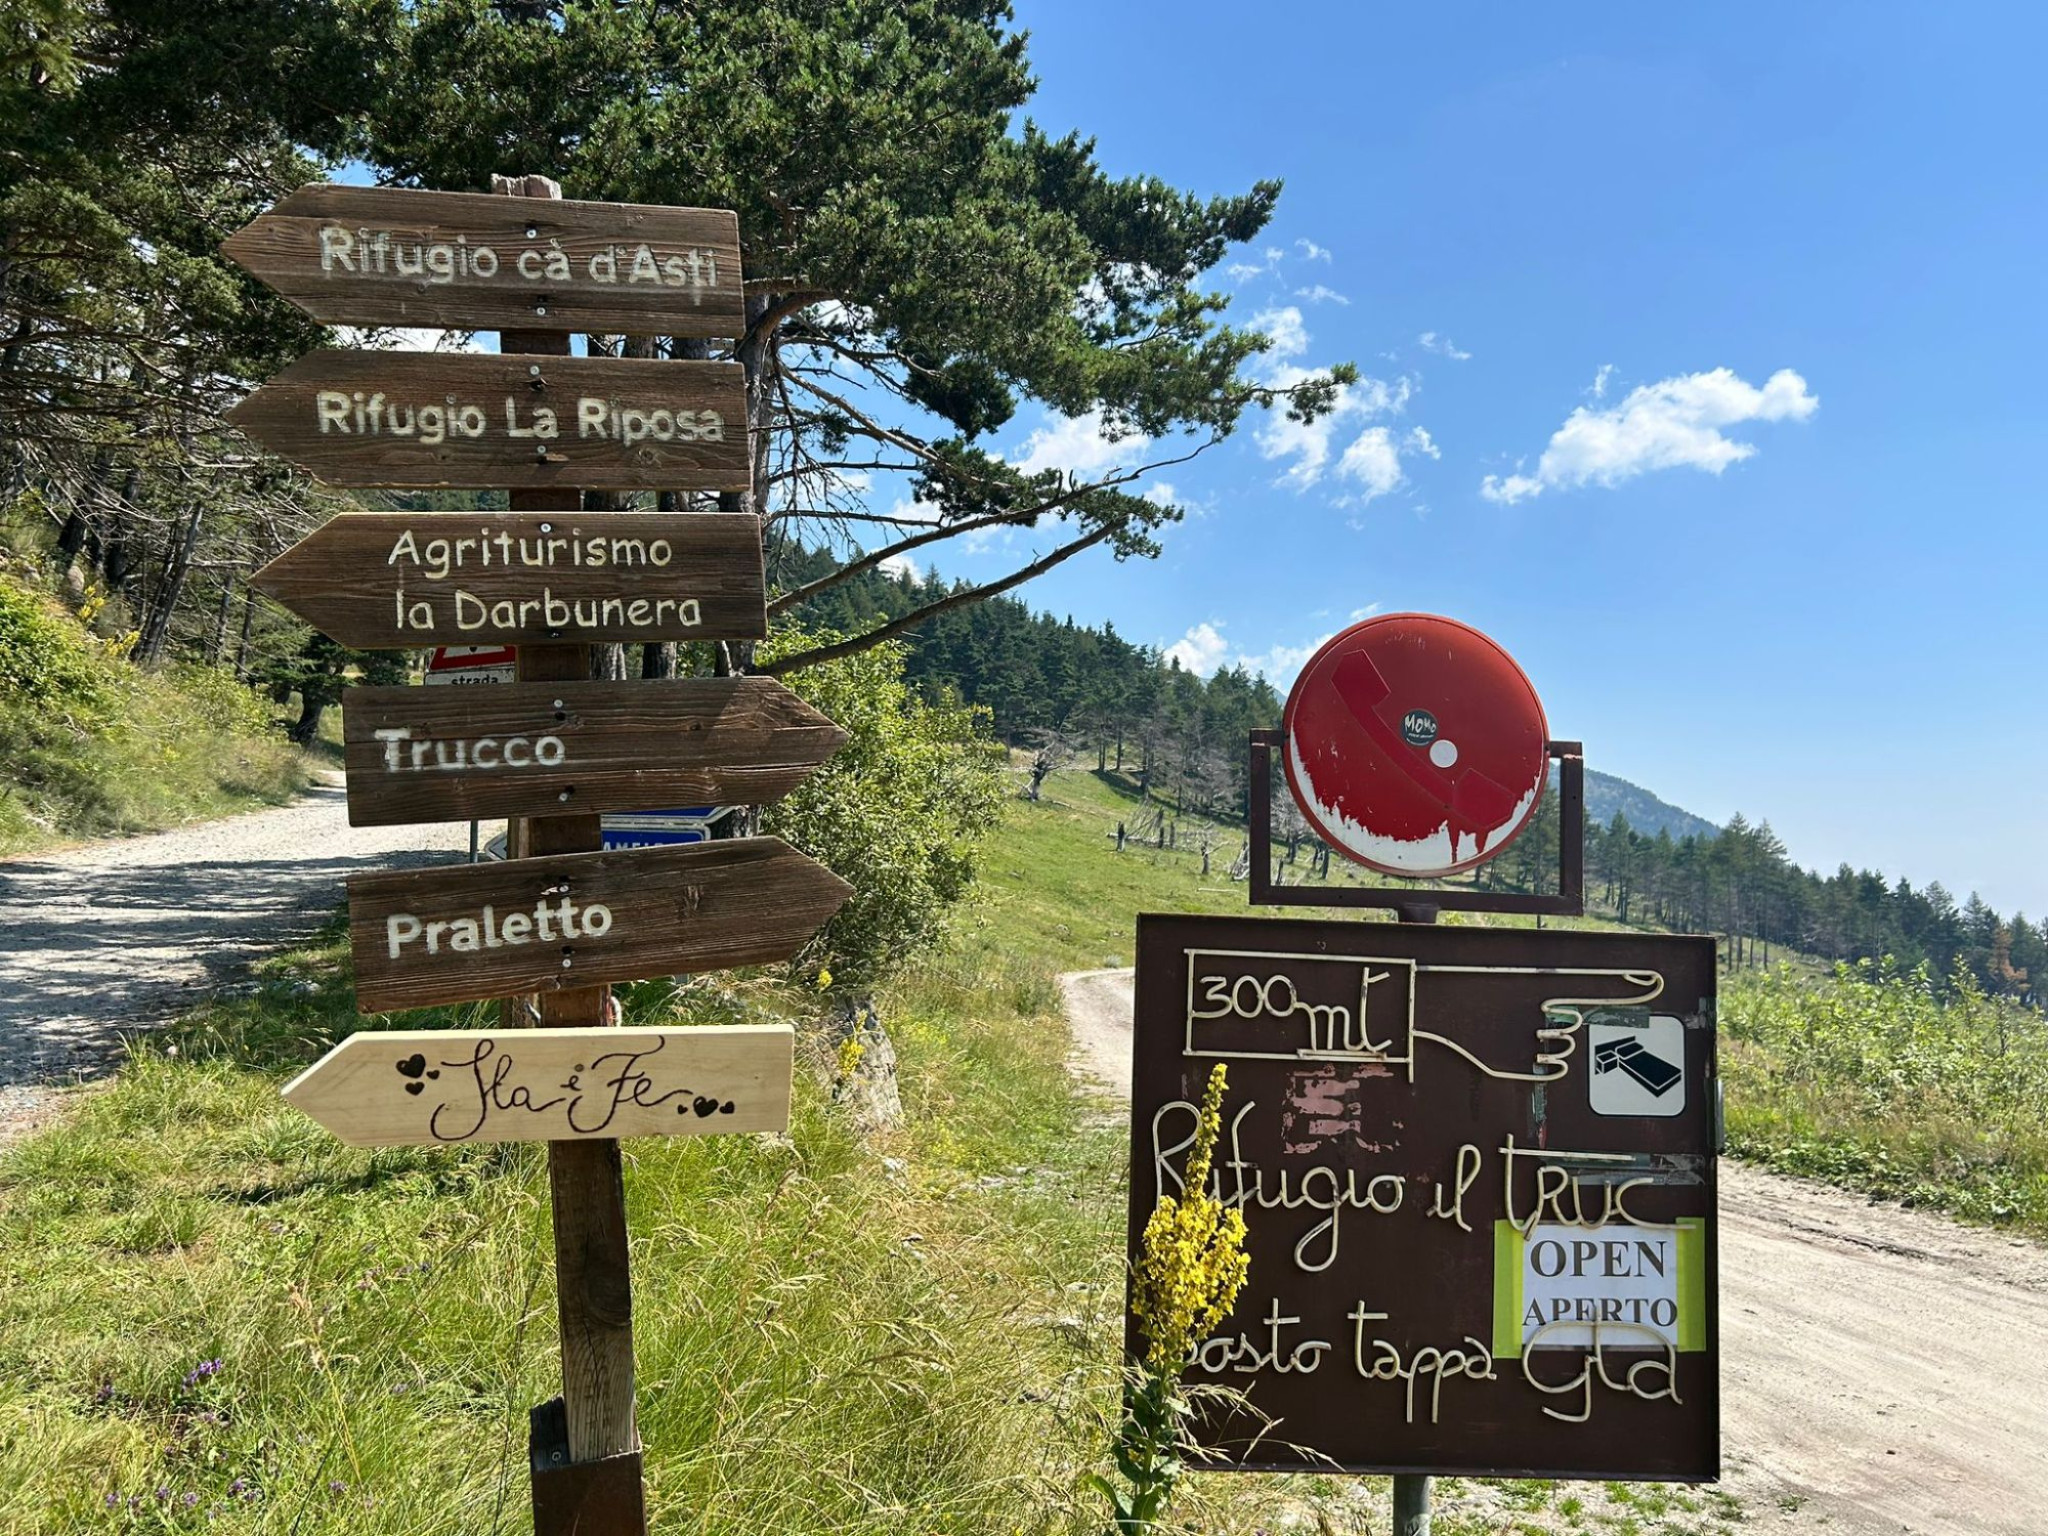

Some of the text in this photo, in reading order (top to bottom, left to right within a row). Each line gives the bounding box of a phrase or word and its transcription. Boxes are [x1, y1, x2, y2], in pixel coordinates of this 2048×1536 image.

[319, 226, 718, 288] Rifugio cà d'Asti
[316, 391, 727, 447] Rifugio La Riposa
[388, 527, 673, 579] Agriturismo
[396, 587, 702, 630] la Darbunera
[374, 729, 566, 773] Trucco
[387, 896, 613, 960] Praletto
[567, 1034, 693, 1133] Fe
[1425, 1143, 1482, 1233] il
[1530, 1239, 1668, 1278] OPEN
[1521, 1297, 1679, 1328] APERTO
[1184, 1297, 1332, 1374] osto
[1346, 1299, 1498, 1424] tappa
